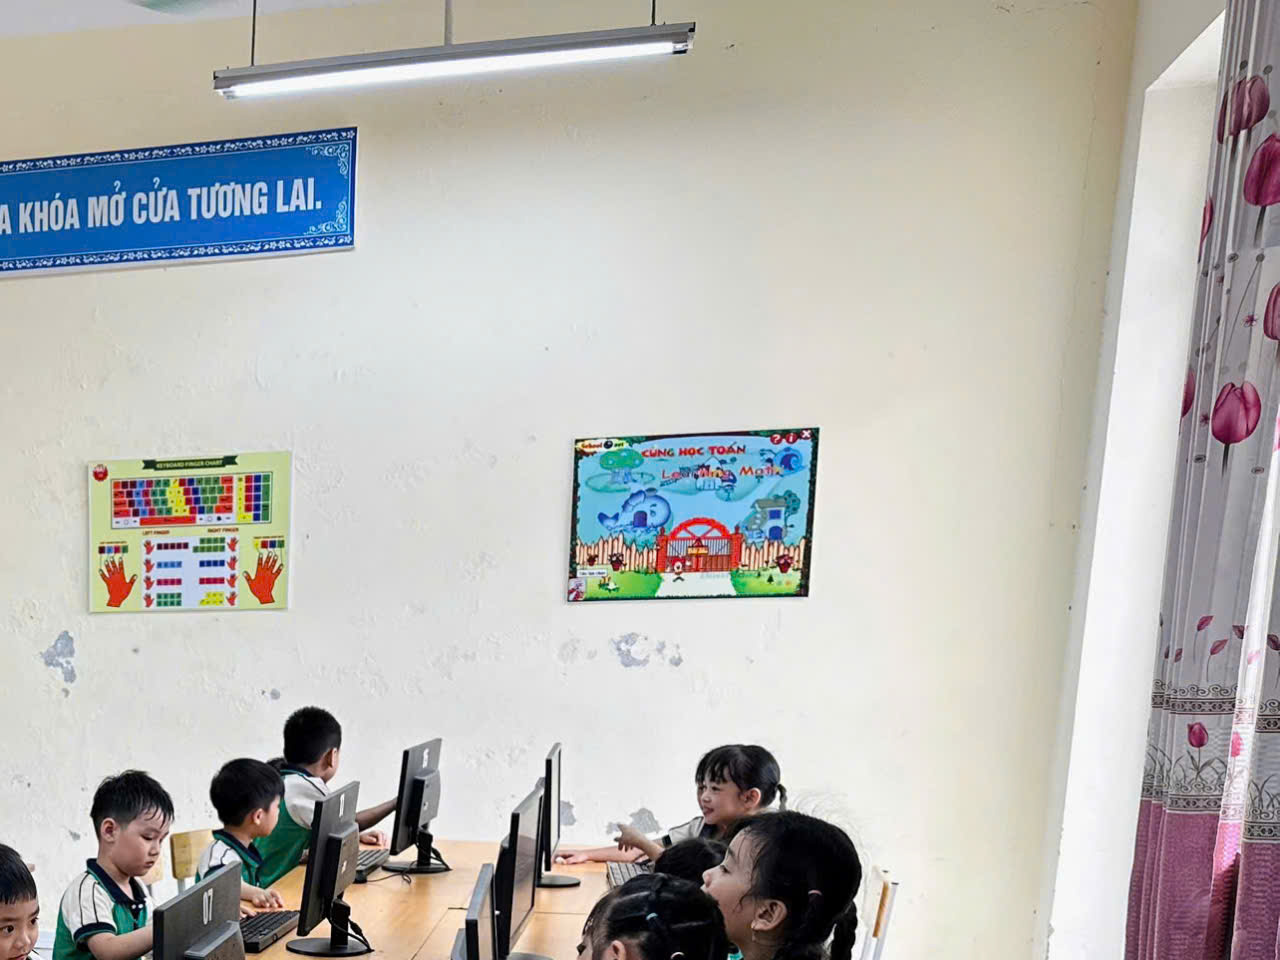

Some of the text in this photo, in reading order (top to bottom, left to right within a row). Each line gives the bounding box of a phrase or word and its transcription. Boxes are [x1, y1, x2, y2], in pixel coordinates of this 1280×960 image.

[18, 192, 80, 233] KHÓA
[87, 180, 126, 228] MỞ
[132, 176, 181, 224] CỬA
[187, 182, 268, 220] TƯƠNG
[276, 177, 322, 213] LAI.
[202, 887, 214, 925] 07
